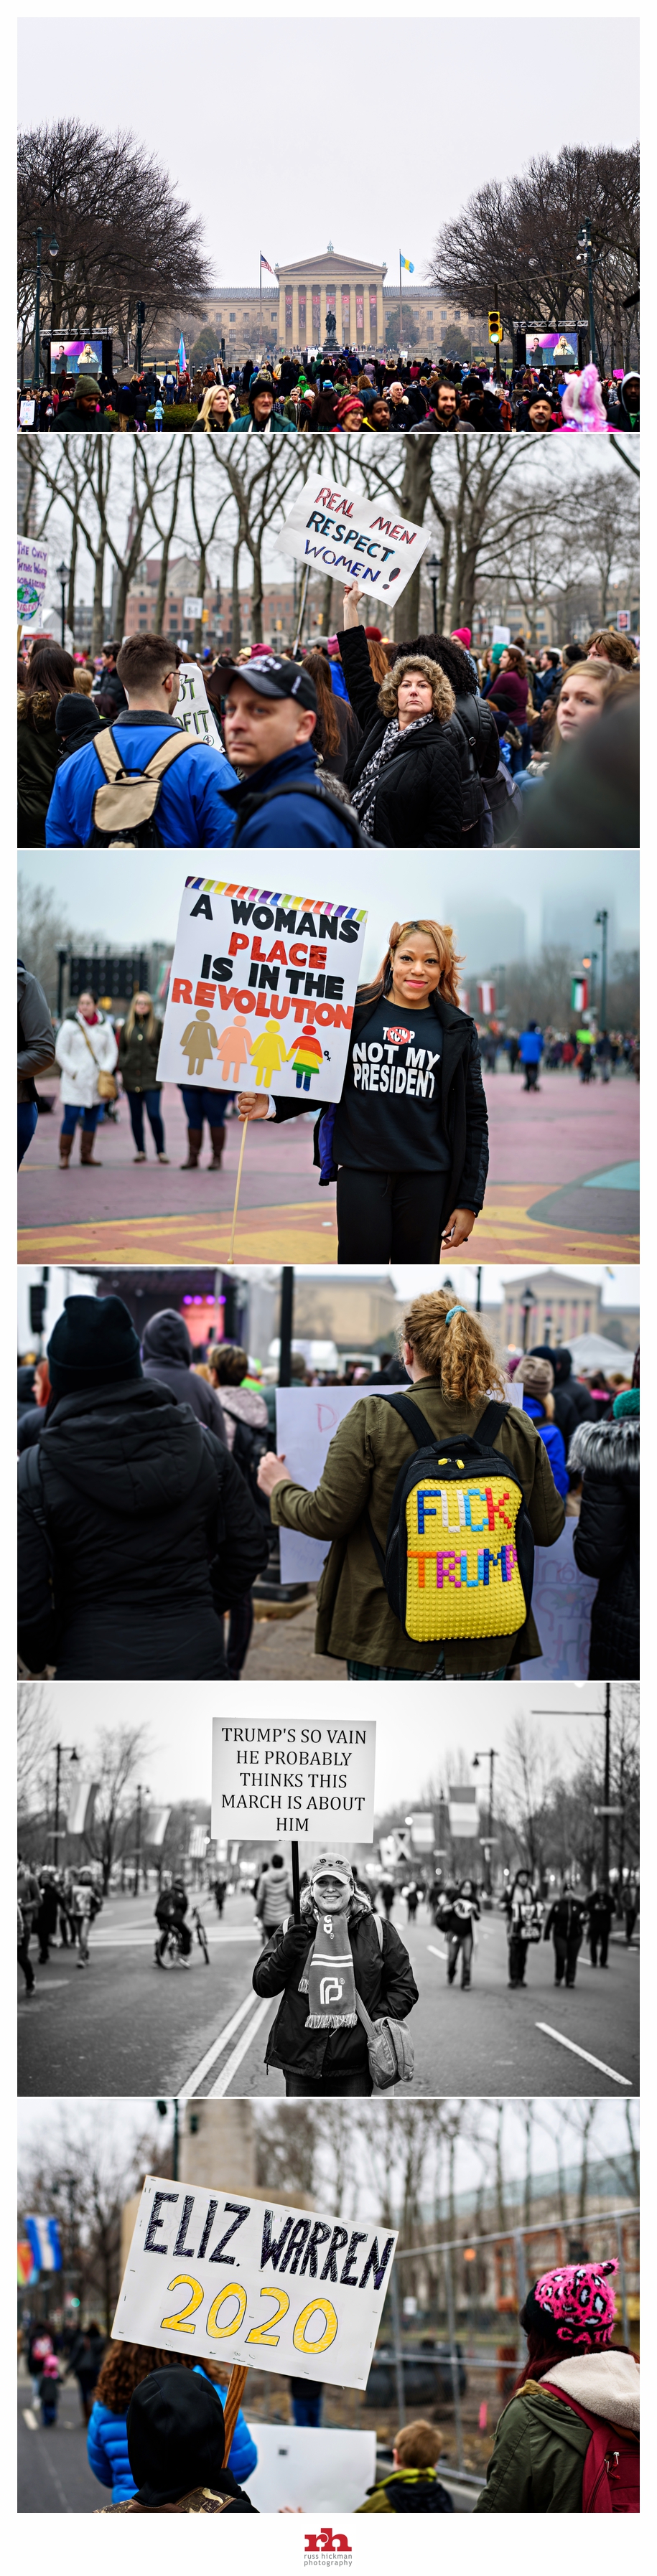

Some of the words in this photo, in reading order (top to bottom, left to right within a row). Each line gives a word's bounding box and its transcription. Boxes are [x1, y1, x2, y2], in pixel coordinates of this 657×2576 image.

[314, 487, 354, 518] REAL
[369, 516, 417, 545] MEN
[305, 510, 396, 562] RESPECT
[177, 677, 195, 702] OT
[190, 893, 213, 921] A
[230, 899, 360, 944] WOMANS
[228, 931, 327, 969] PLACE
[200, 954, 233, 982] IS
[248, 962, 281, 991] IN
[285, 969, 345, 1000] THE
[171, 977, 354, 1030] REVOLUTION
[383, 1027, 415, 1044] TRUMP
[352, 1042, 400, 1065] NOT
[405, 1047, 441, 1071] MY
[353, 1063, 436, 1099] PRESIDENT
[416, 1487, 513, 1534] FUCK
[406, 1544, 518, 1589] TRUMP
[221, 1727, 296, 1743] TRUMP'S
[301, 1729, 322, 1744] SO
[327, 1729, 366, 1744] VAIN
[236, 1750, 259, 1764] HE
[264, 1751, 353, 1766] PROBABLY
[240, 1772, 303, 1787] THINKS
[308, 1774, 348, 1788] THIS
[221, 1794, 282, 1809] MARCH
[287, 1795, 302, 1810] IS
[306, 1796, 365, 1811] ABOUT
[276, 1818, 309, 1832] HIM
[144, 2191, 251, 2267] ELIZ.
[261, 2209, 395, 2290] WARREN
[160, 2273, 338, 2354] 2020
